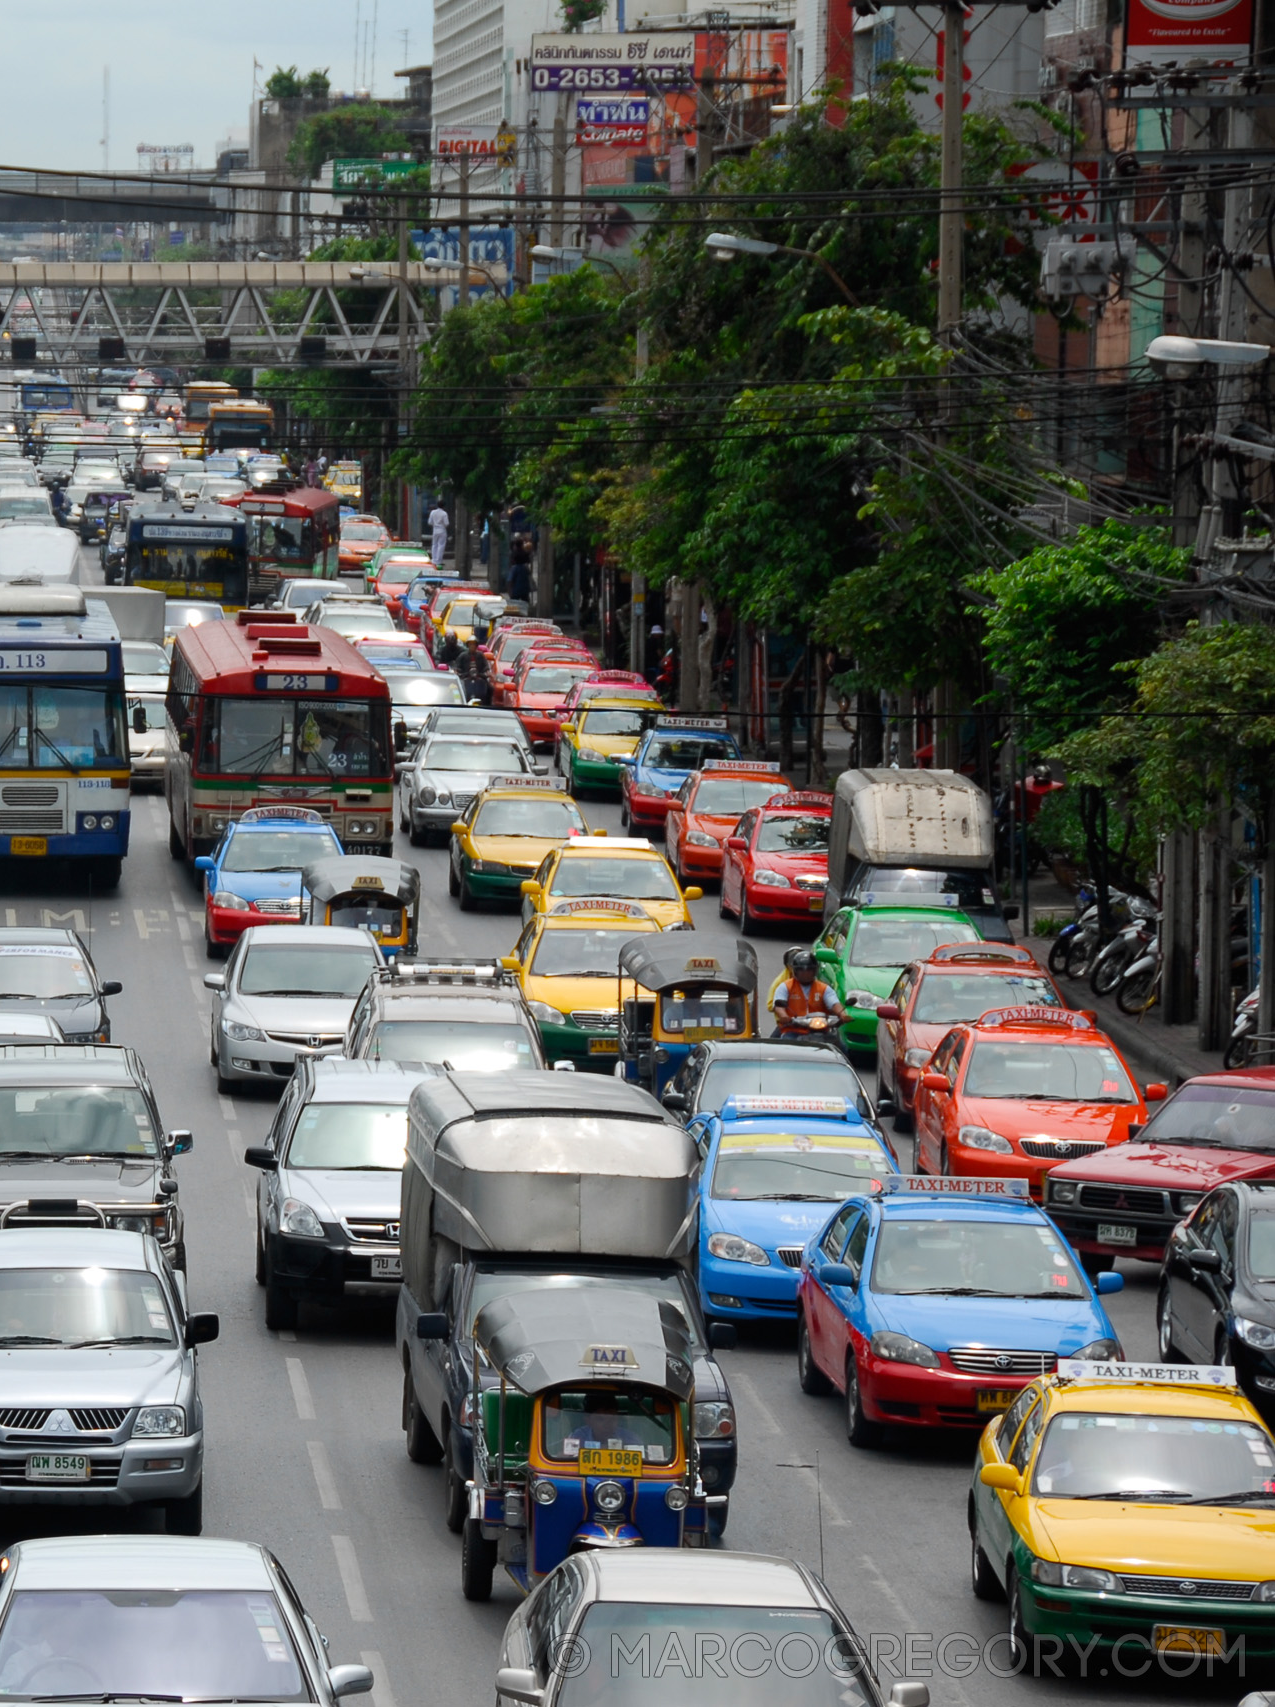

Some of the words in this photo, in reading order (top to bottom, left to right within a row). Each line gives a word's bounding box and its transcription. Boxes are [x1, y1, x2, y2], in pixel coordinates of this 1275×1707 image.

[534, 45, 622, 59] คลินิกทันตกรรม
[578, 100, 647, 122] ทำฟัน
[582, 125, 644, 146] Colgate
[16, 654, 46, 668] 113
[282, 675, 308, 690] 23
[328, 753, 347, 768] 23
[565, 900, 630, 913] TAXI-METER
[692, 959, 714, 967] TAXI
[998, 1008, 1076, 1024] TAXI-METER
[907, 1178, 1005, 1193] TAXI-METER
[590, 1349, 627, 1362] TAXI
[1094, 1365, 1200, 1381] TAXI-METER
[54, 1456, 85, 1470] 8549
[582, 1451, 601, 1464] สก
[608, 1451, 640, 1466] 1986
